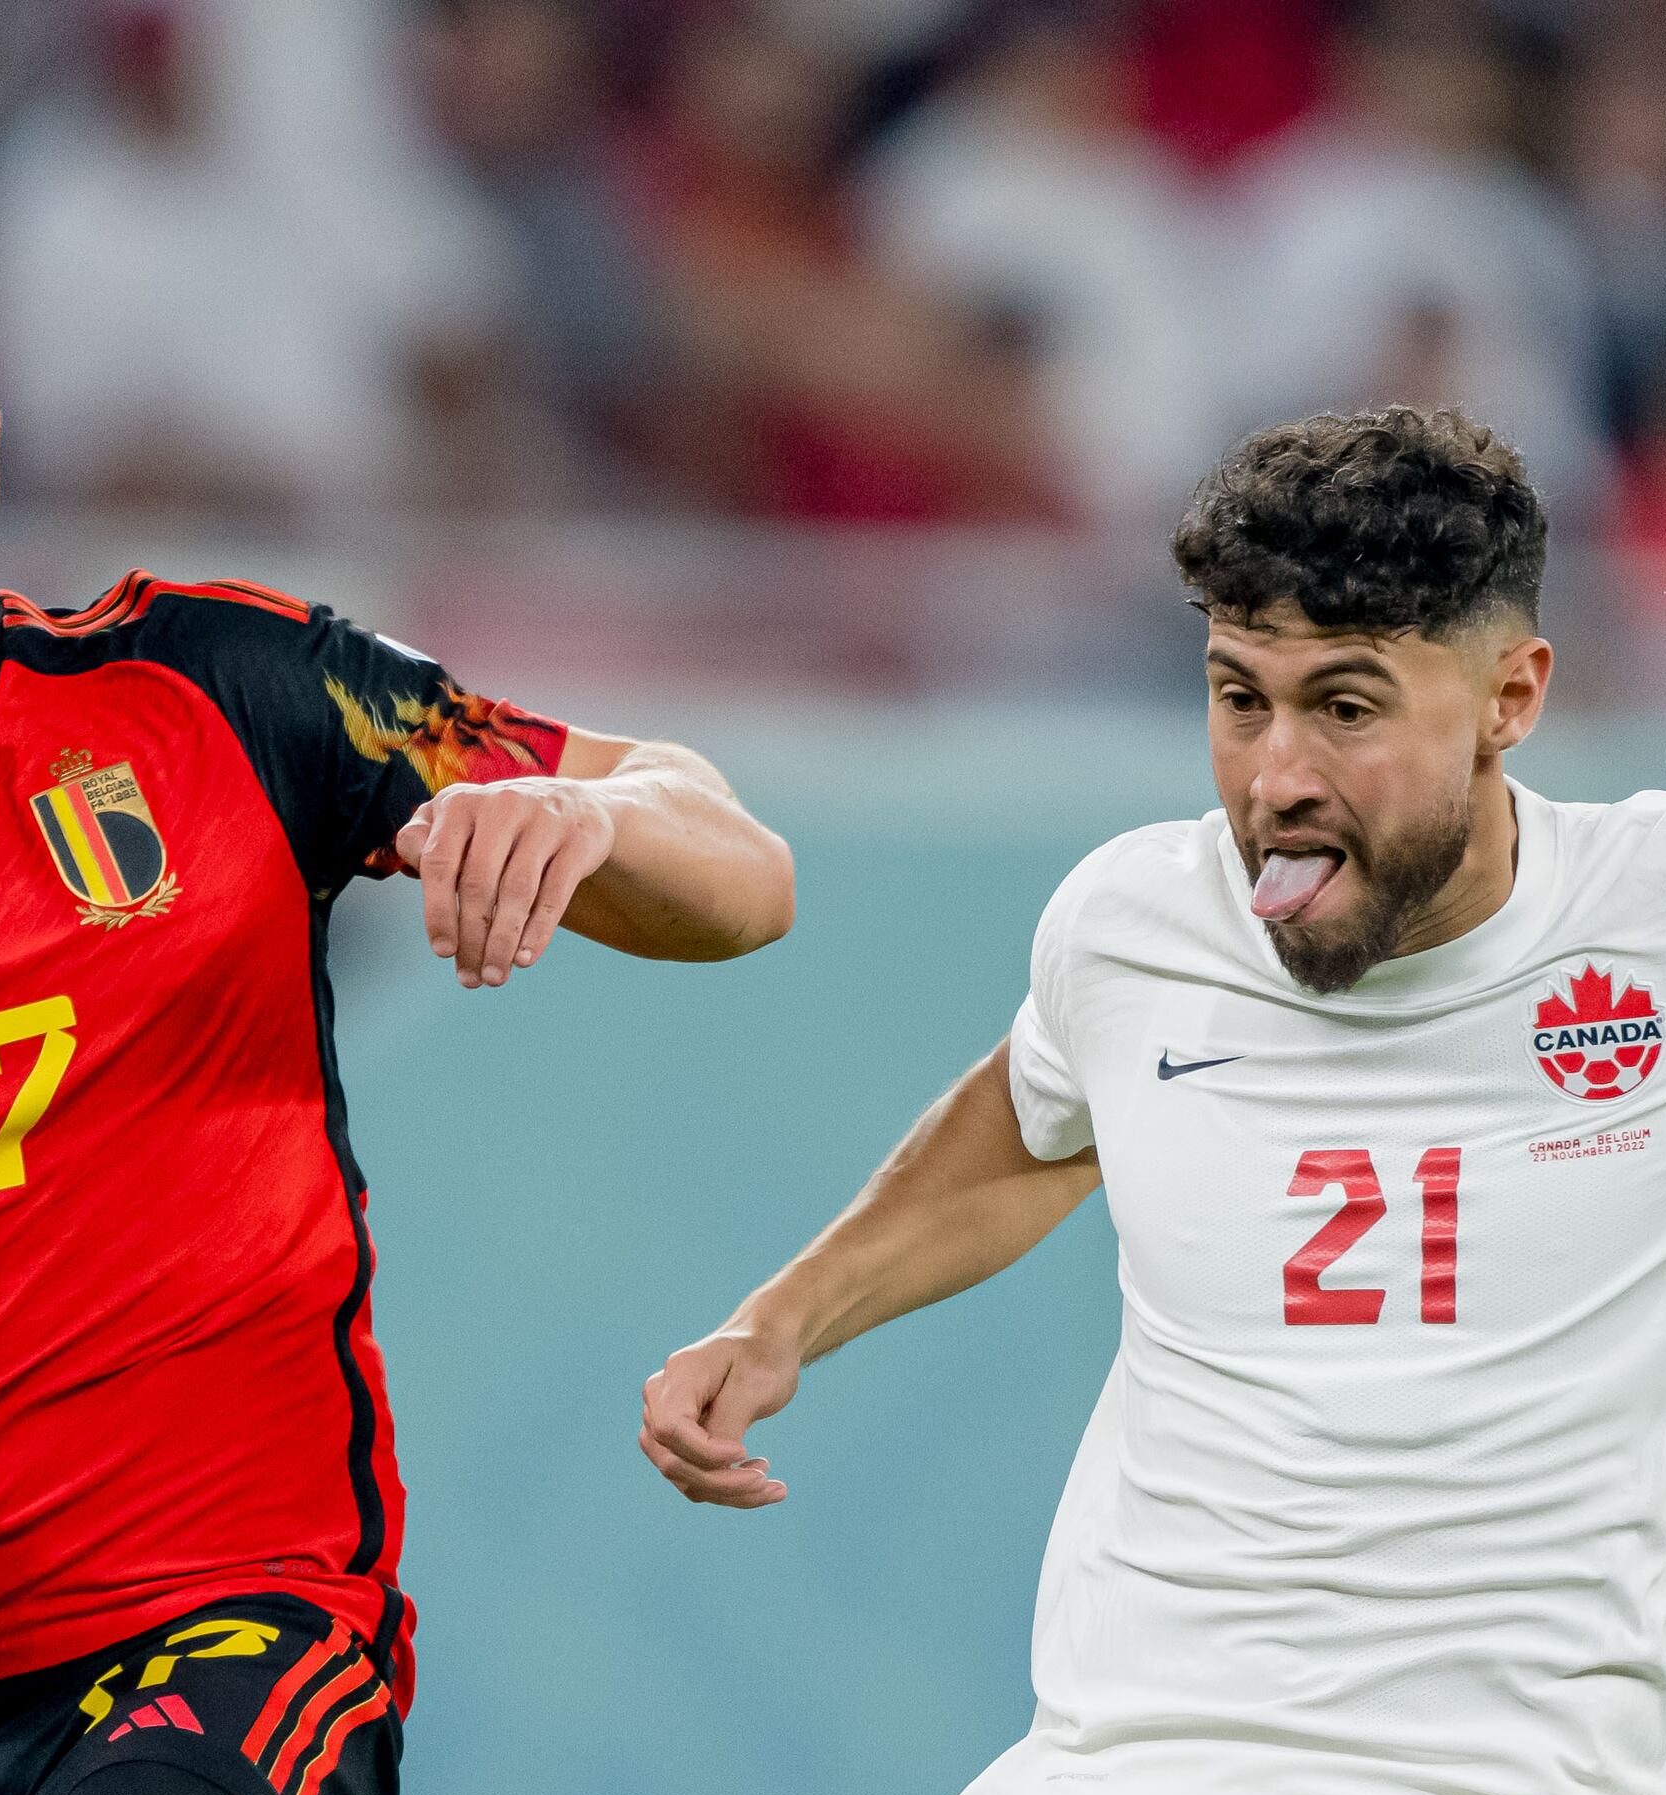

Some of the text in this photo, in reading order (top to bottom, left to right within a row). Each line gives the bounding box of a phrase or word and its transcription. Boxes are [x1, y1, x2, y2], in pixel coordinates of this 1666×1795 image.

[81, 771, 118, 790] ROYAL
[86, 776, 134, 800] BELGIAN
[1533, 1020, 1663, 1052] CANADA
[1528, 1138, 1581, 1153] CANADA
[1596, 1128, 1651, 1146] BELGIUM
[1532, 1140, 1645, 1162] 23 NOVEMBER 2022
[1283, 1147, 1462, 1326] 21
